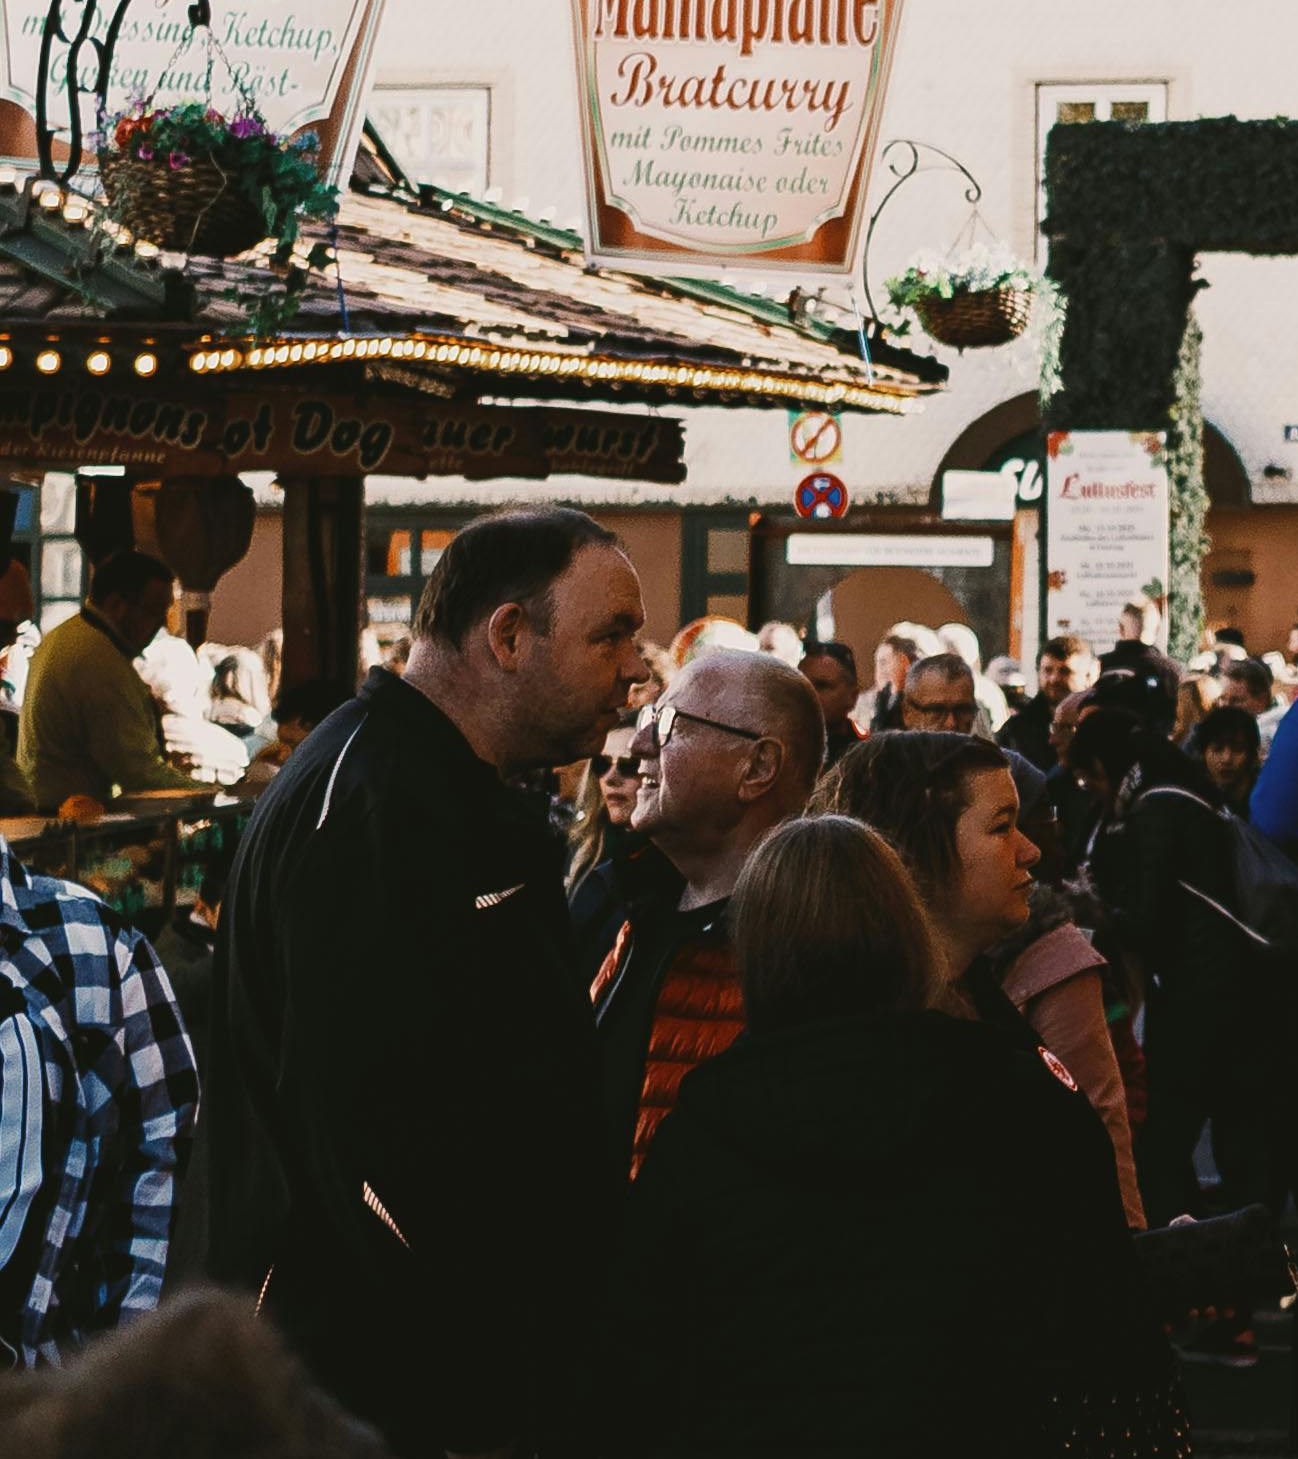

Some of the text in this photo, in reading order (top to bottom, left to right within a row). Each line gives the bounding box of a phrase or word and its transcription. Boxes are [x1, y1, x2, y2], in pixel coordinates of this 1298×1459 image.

[610, 52, 854, 133] Bratcurry
[610, 125, 844, 158] mit Pommes Frites
[622, 160, 831, 196] Mayonaise oder
[668, 198, 778, 239] Ketchup
[223, 398, 395, 471] ot Dog
